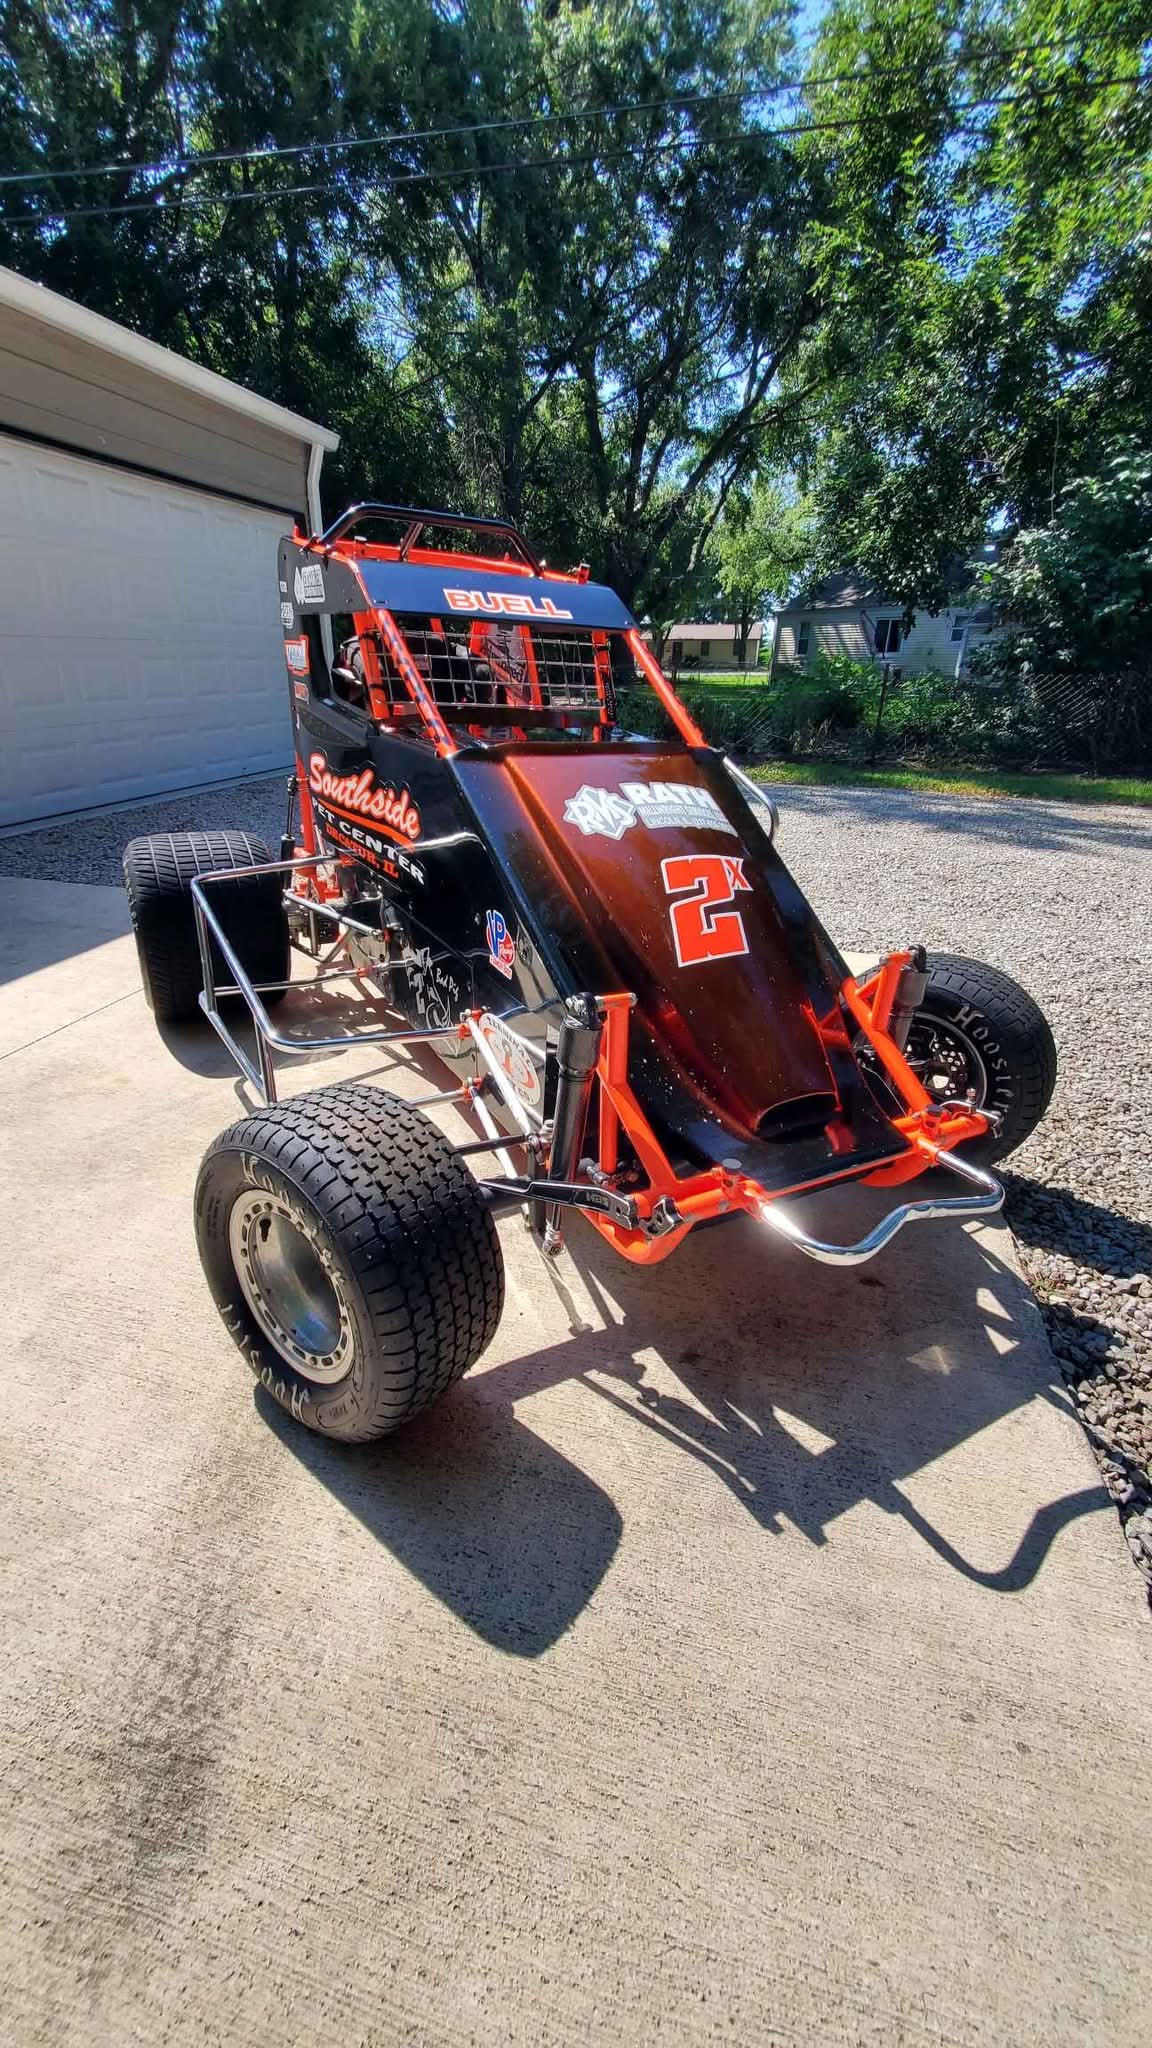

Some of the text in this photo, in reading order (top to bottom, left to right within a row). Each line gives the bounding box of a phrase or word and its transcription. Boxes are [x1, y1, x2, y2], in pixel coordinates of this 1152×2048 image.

[443, 588, 573, 619] BUELL
[309, 753, 421, 839] Southside
[619, 782, 722, 812] RATH
[312, 796, 425, 885] PET CENTER
